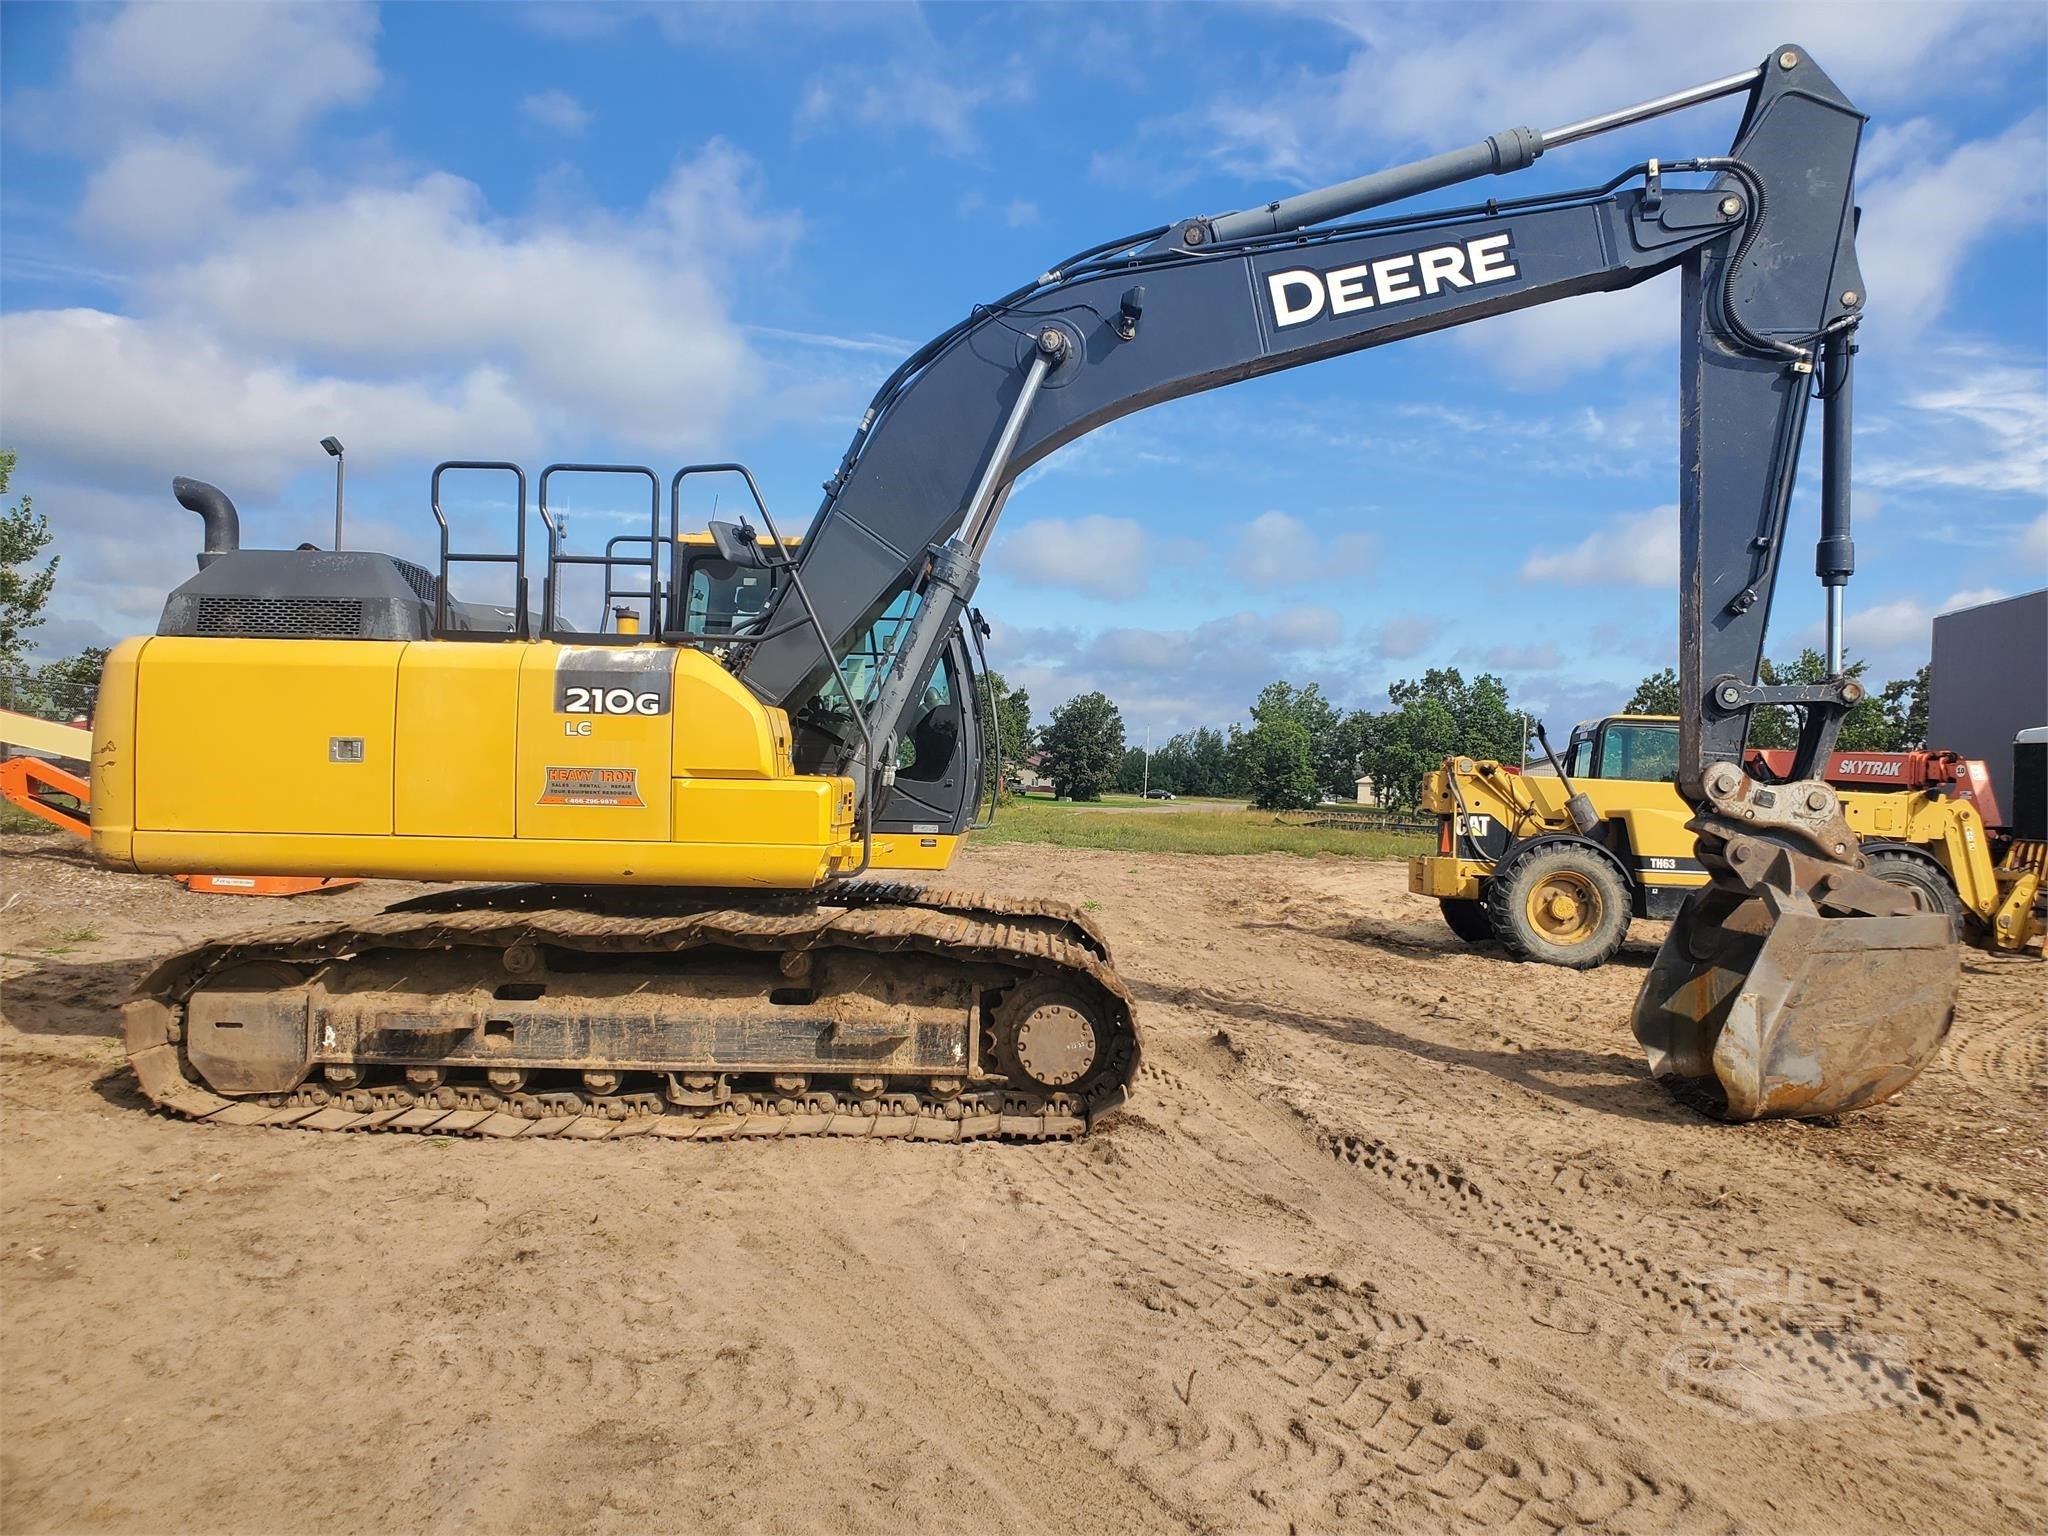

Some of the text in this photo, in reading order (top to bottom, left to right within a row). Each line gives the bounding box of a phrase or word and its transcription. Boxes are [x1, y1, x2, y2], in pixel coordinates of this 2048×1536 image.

[1267, 233, 1516, 327] DEERE
[564, 686, 660, 716] 210G
[565, 721, 592, 736] LC
[548, 769, 635, 783] HEAVY IRON
[1839, 759, 1903, 777] SKYTRAK
[1456, 815, 1491, 837] CAT
[1650, 858, 1676, 869] TH63
